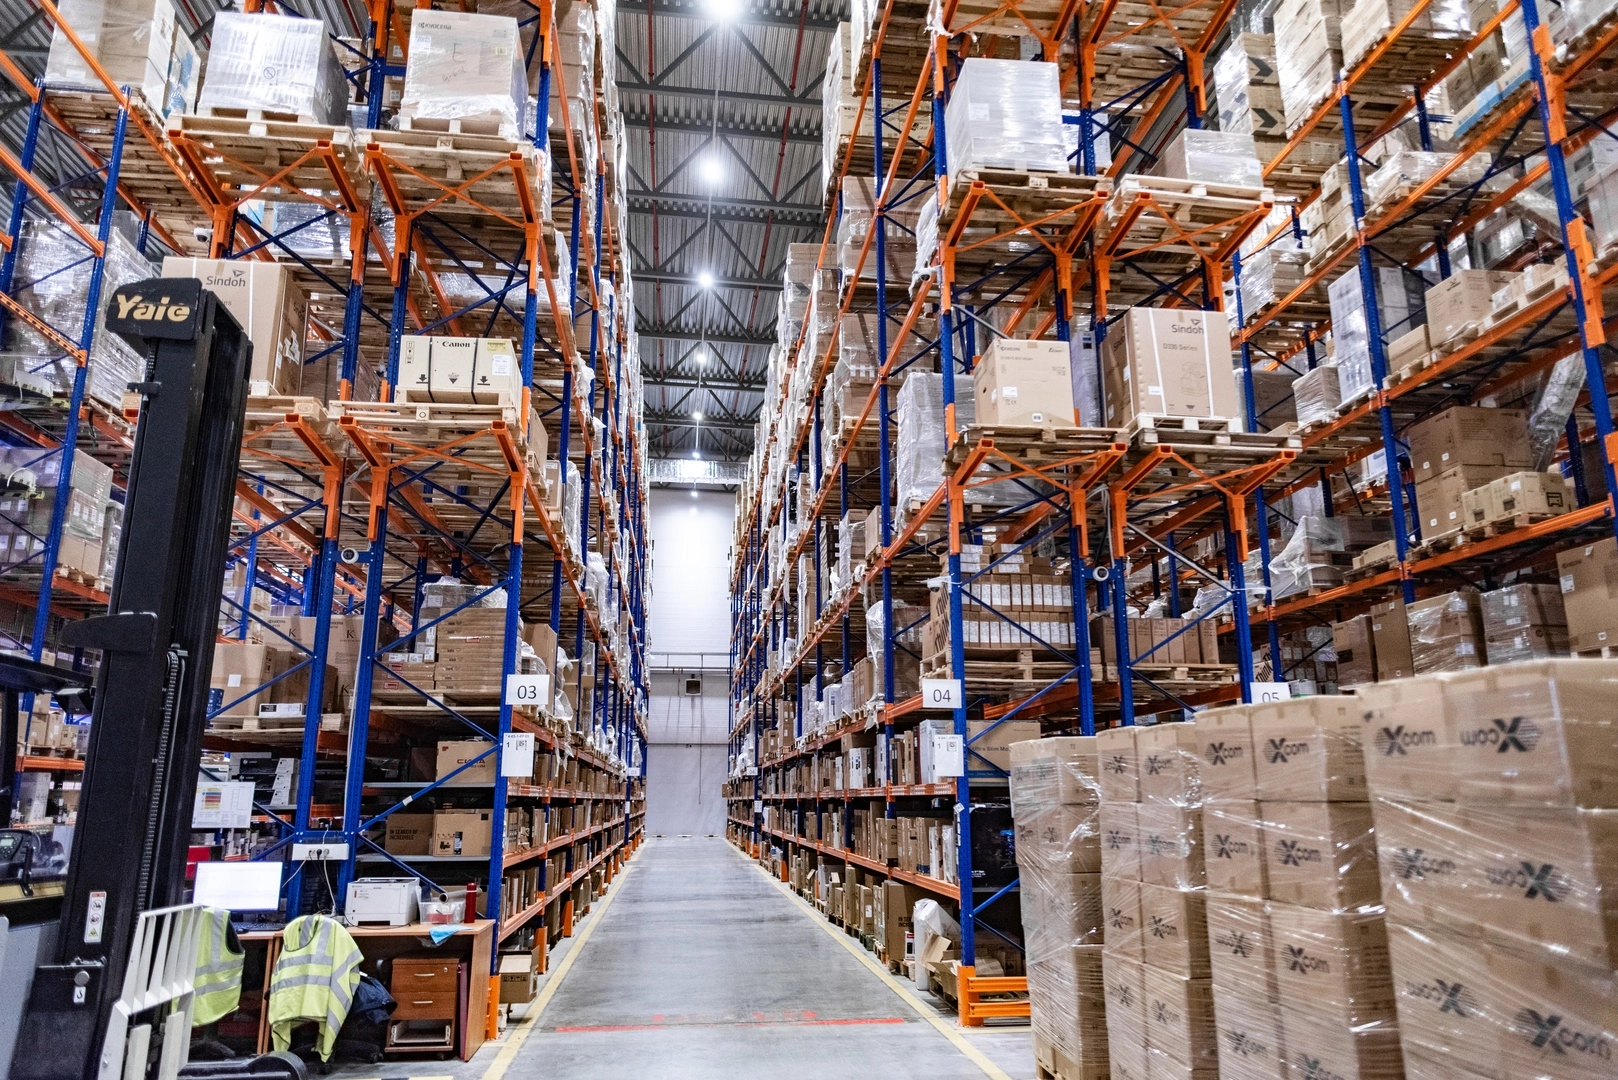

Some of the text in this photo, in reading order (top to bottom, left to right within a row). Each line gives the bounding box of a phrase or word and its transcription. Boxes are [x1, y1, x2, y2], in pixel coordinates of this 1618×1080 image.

[206, 275, 246, 288] Sindoh
[1171, 324, 1204, 334] Sindoh
[442, 340, 470, 348] Canon
[1179, 343, 1198, 351] Series
[289, 628, 297, 638] K
[346, 630, 355, 639] K
[341, 684, 349, 693] K
[517, 685, 537, 699] 03
[933, 689, 951, 702] 04
[1262, 692, 1279, 703] 05
[1374, 725, 1436, 755] Xcom
[1460, 716, 1542, 753] Xcom
[1204, 742, 1243, 765] Xcom
[1262, 738, 1310, 763] Xcom
[1210, 834, 1249, 859] Xcom
[1273, 839, 1322, 866] Xcom
[1391, 848, 1456, 879] Xcom
[1280, 943, 1330, 975] Xcom
[1515, 1008, 1611, 1060] Xcom
